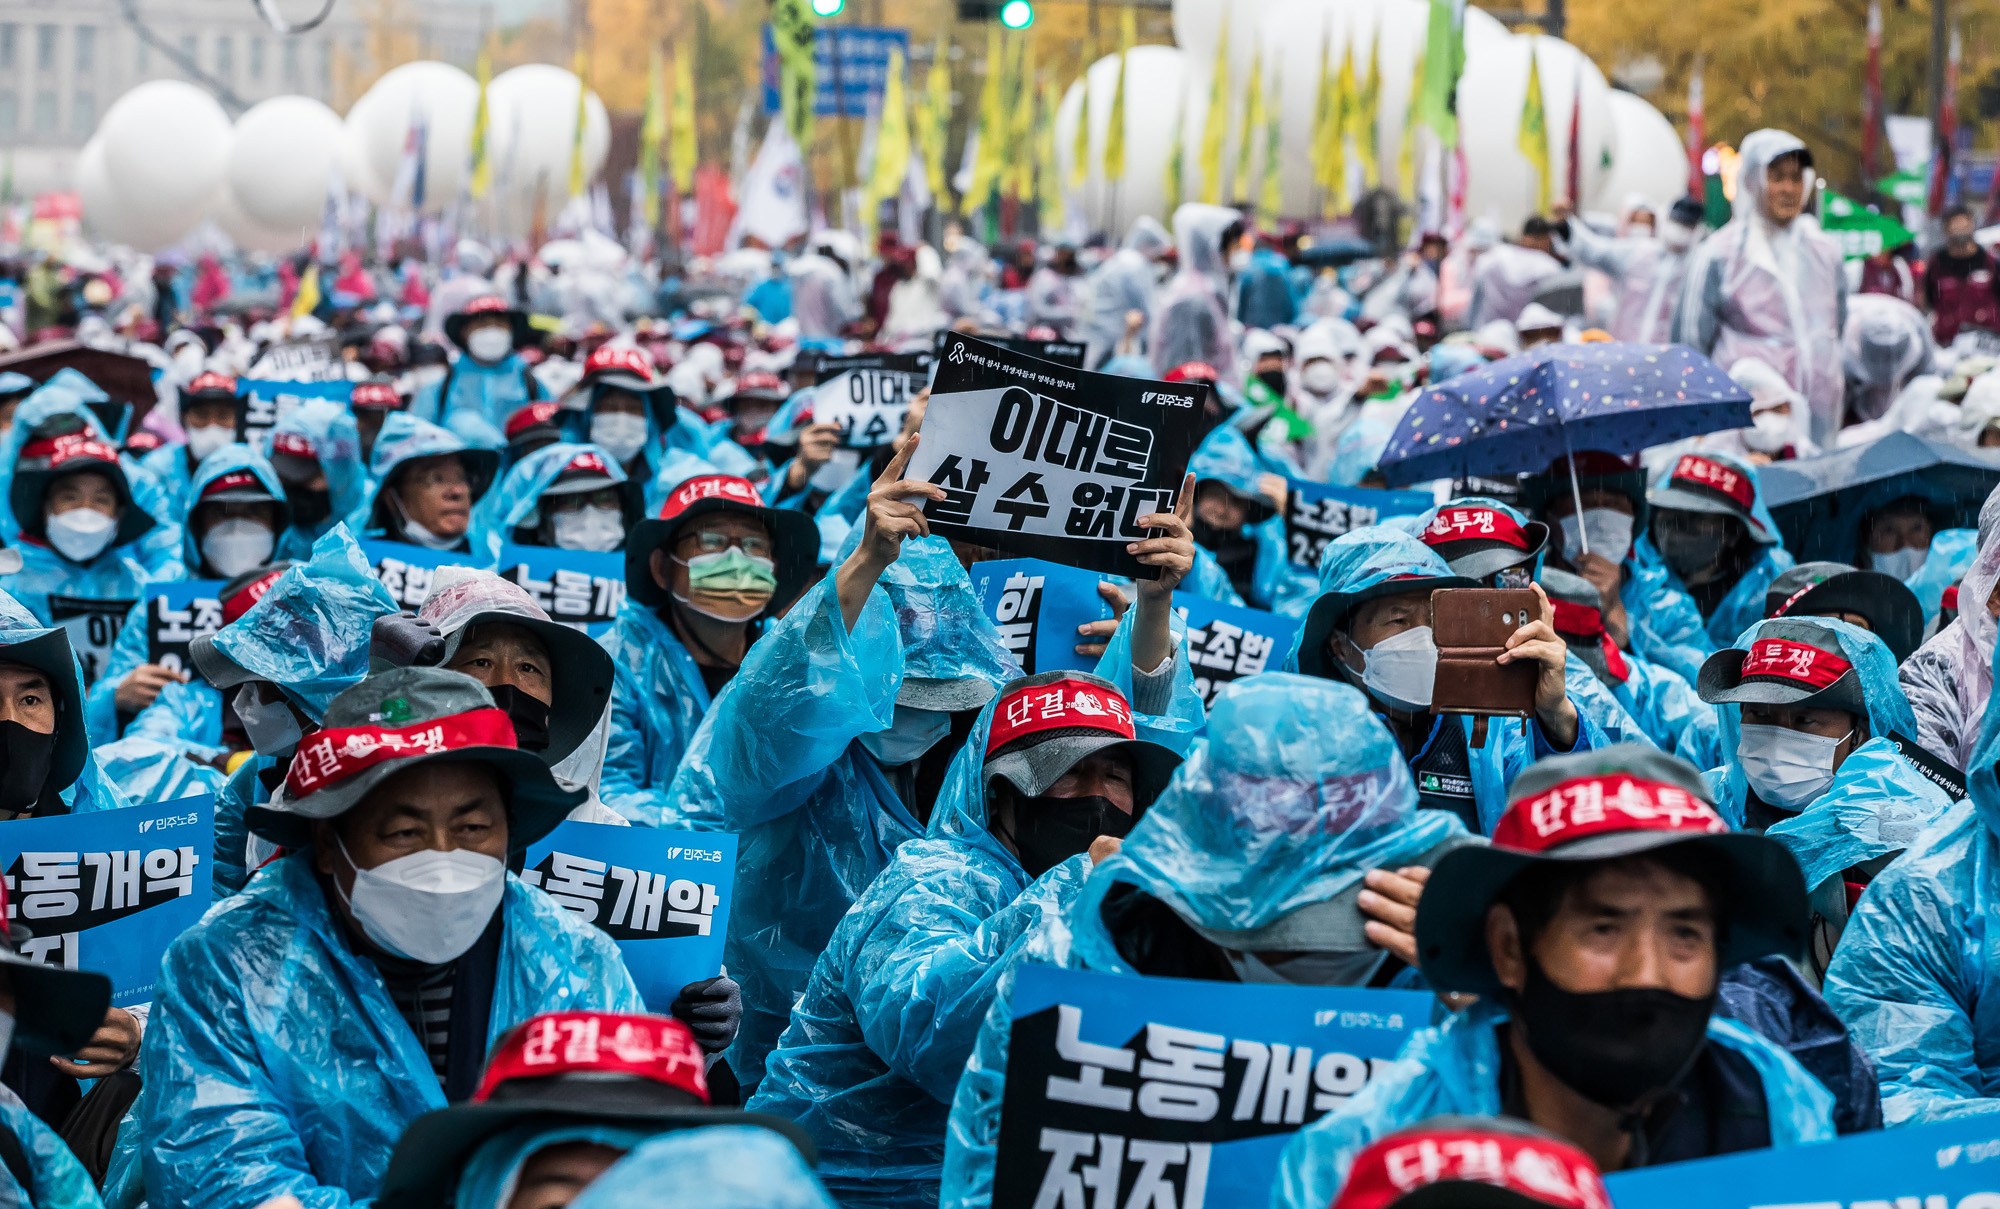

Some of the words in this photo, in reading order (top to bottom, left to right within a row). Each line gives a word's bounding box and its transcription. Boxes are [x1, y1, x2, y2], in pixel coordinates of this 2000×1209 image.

[964, 352, 985, 366] 이태원
[986, 359, 1000, 370] 참사
[1001, 364, 1036, 381] 희생자들의
[1156, 392, 1195, 409] 민주노총
[989, 385, 1155, 483] 이대로
[922, 453, 991, 525] 살
[992, 471, 1051, 531] 수
[1064, 481, 1177, 539] 없다
[1450, 510, 1496, 534] 투쟁
[371, 557, 434, 606] 조법
[516, 562, 627, 618] 노동개
[157, 594, 225, 643] 노조
[1760, 643, 1817, 678] 투쟁
[1007, 689, 1066, 728] 단결
[292, 737, 343, 788] 단결
[379, 725, 448, 755] 투쟁
[155, 811, 199, 831] 민주노총
[1530, 780, 1607, 838] 단결
[683, 848, 723, 863] 민주노총
